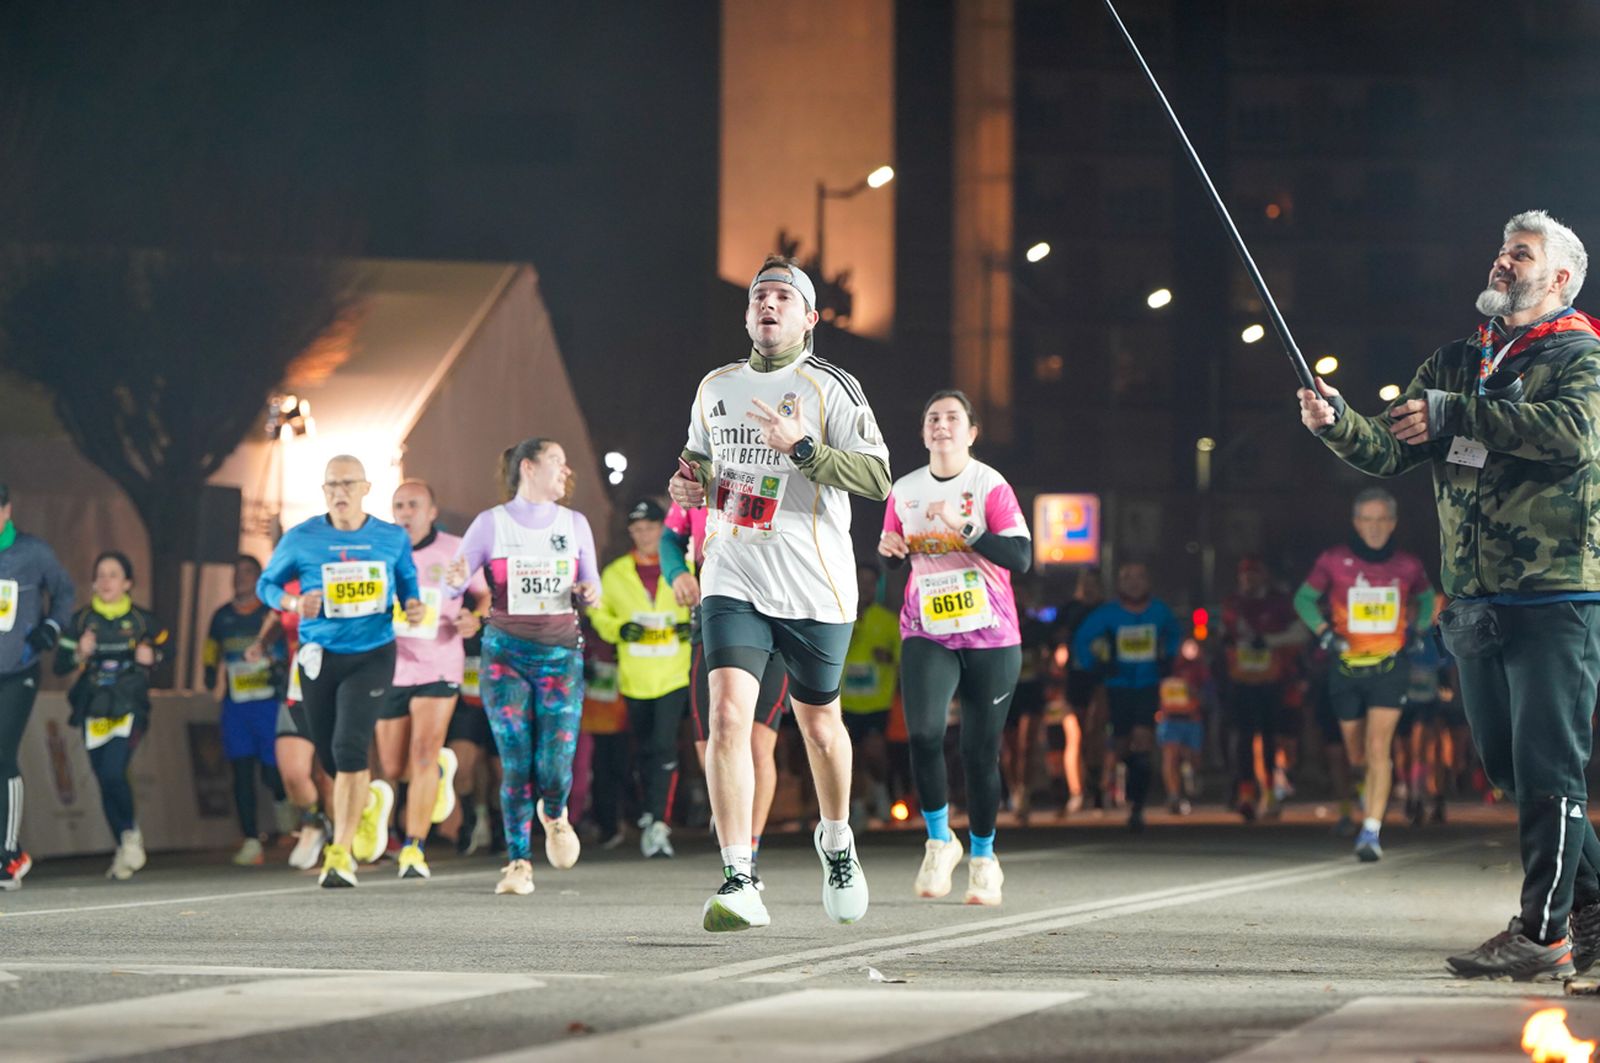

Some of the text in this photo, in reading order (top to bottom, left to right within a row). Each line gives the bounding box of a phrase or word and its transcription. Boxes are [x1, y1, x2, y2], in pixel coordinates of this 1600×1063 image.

[739, 448, 781, 466] BETTER
[746, 476, 755, 485] DE
[723, 489, 765, 520] 36
[336, 581, 376, 599] 9546
[521, 577, 561, 594] 3542
[932, 590, 975, 614] 6618
